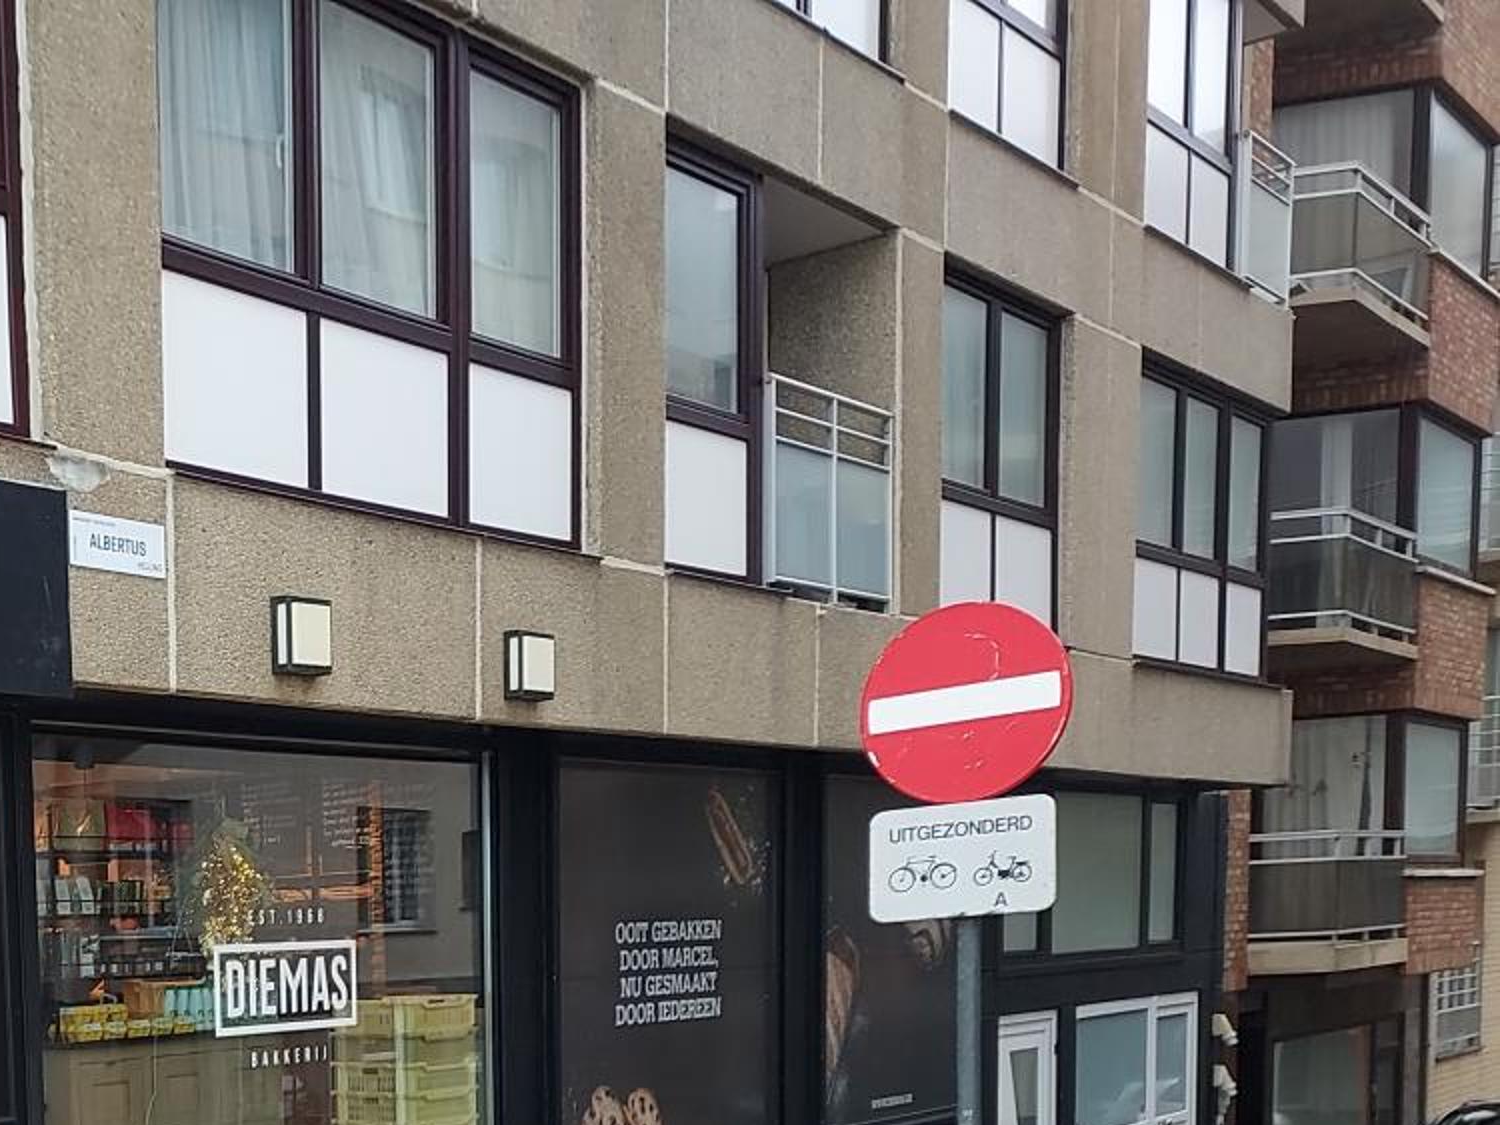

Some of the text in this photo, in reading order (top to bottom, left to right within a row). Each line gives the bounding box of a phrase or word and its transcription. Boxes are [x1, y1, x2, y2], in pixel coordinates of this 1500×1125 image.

[89, 533, 147, 557] ALBERTUS
[889, 815, 1033, 844] UITGEZONDERD
[994, 891, 1008, 907] A
[615, 918, 722, 944] OOIT GEBAKKEN
[619, 945, 719, 970] DOOR MARCEL,
[225, 954, 350, 1019] DIEMAS
[620, 971, 718, 998] NU GESMAAKT
[615, 996, 722, 1026] DOOR IEDEREEN
[250, 1045, 329, 1069] BAKKERIJ
